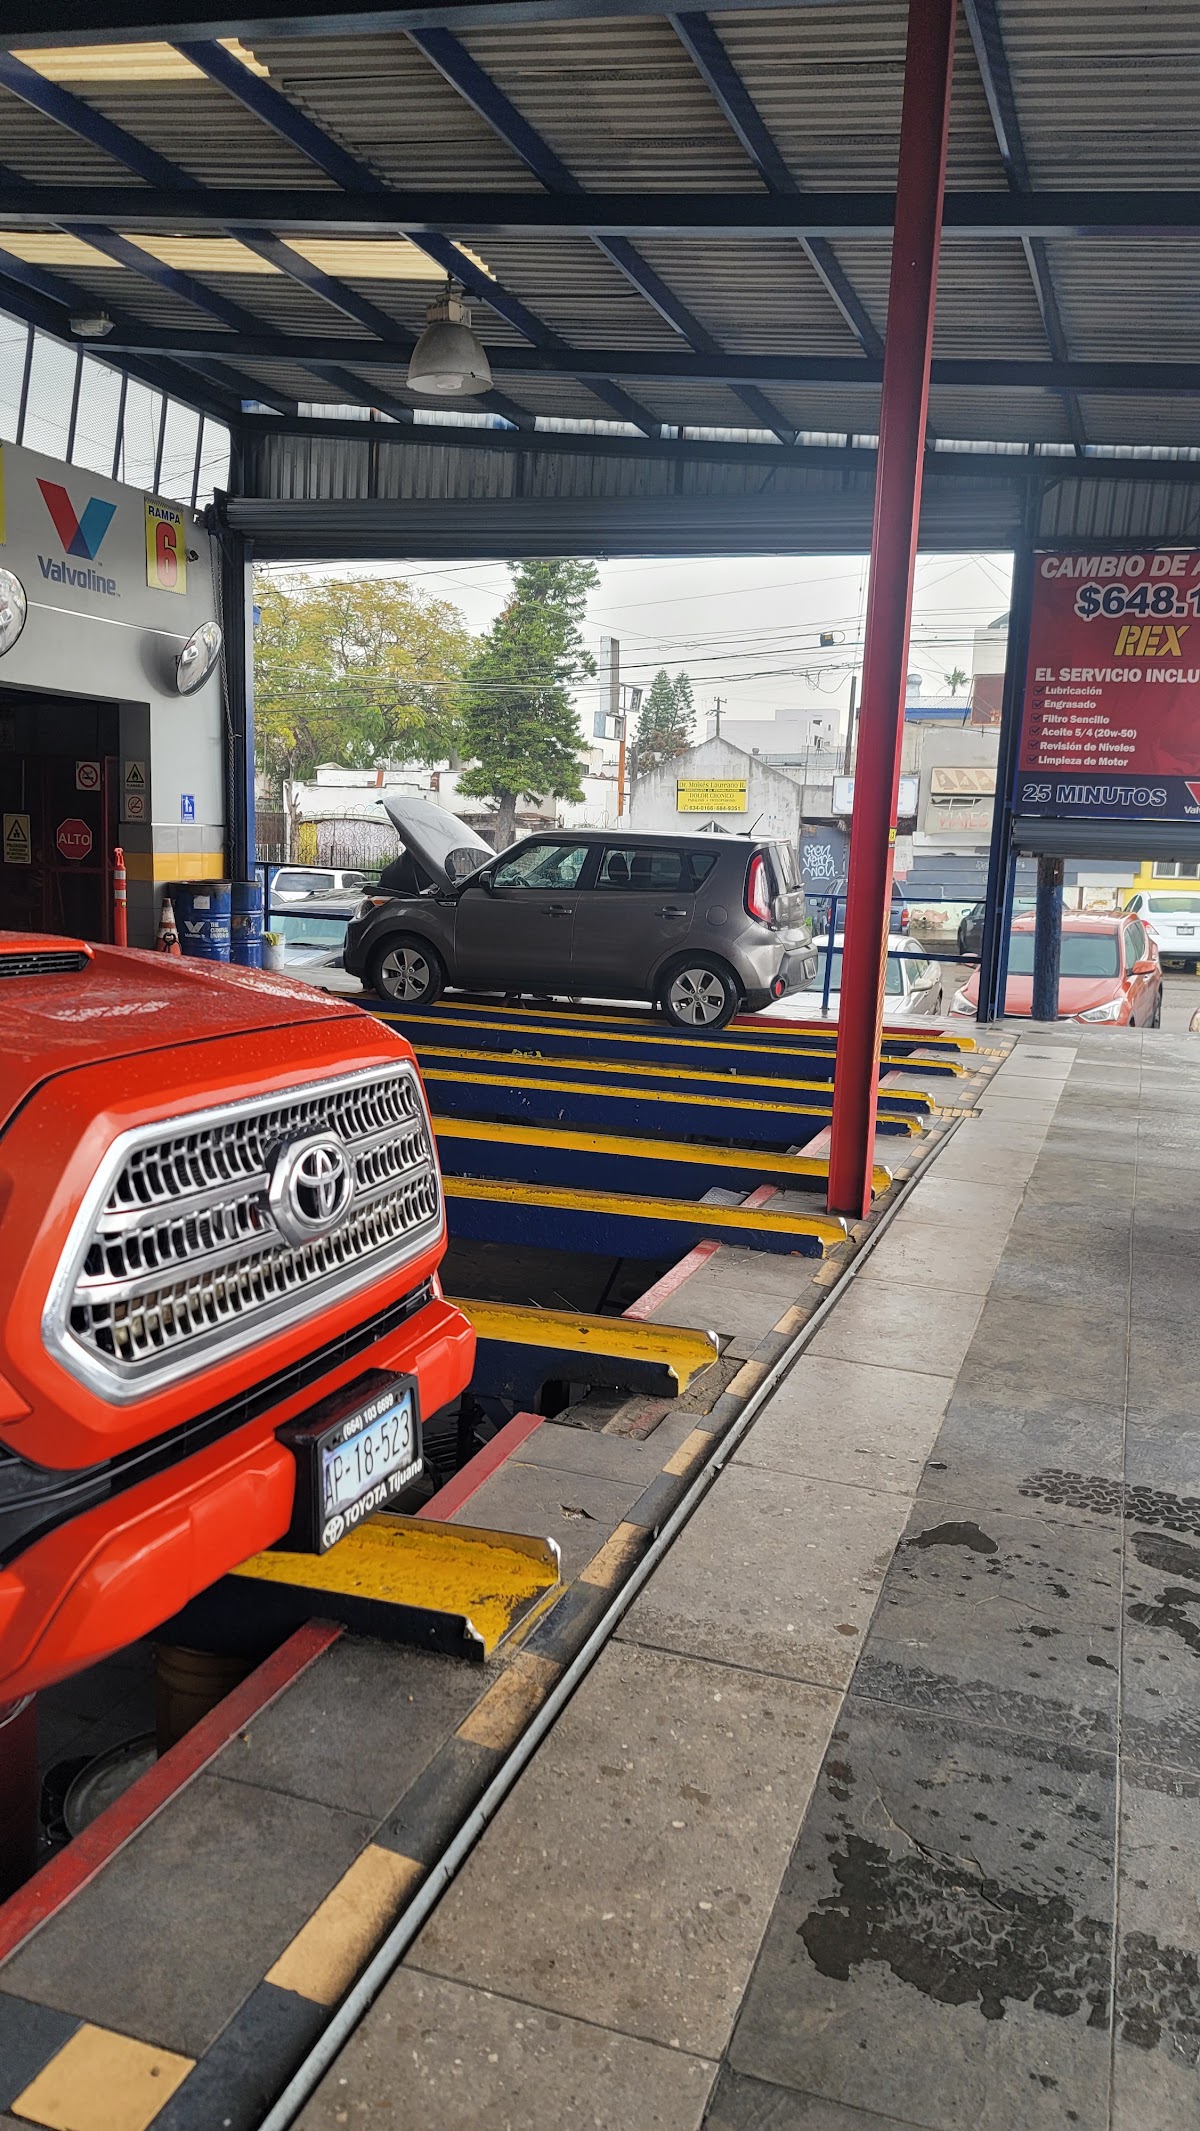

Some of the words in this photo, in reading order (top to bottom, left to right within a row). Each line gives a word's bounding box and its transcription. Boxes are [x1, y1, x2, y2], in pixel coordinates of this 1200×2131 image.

[148, 505, 181, 525] RAMPA
[155, 522, 177, 587] 6
[37, 555, 117, 595] Valvoline
[1040, 555, 1145, 579] CAMBIO
[1149, 555, 1190, 577] DE
[1114, 625, 1190, 657] REX
[1035, 668, 1055, 682] EL
[1059, 667, 1142, 683] SERVICIO
[1045, 686, 1102, 695] Lubricación
[1044, 700, 1096, 709] Engrasado
[1042, 714, 1068, 723] Filtro
[1070, 715, 1110, 724] Sencillo
[1041, 727, 1073, 736] Aceite
[1075, 728, 1093, 738] 5/4
[1094, 729, 1137, 739] (20w-50)
[1040, 741, 1082, 751] Revisión
[1083, 742, 1097, 751] de
[1098, 743, 1136, 753] Niveles
[1038, 756, 1082, 765] Limpieza
[1083, 757, 1097, 765] de
[1098, 757, 1129, 766] Motor
[1022, 784, 1052, 802] 25
[1056, 785, 1167, 806] MINUTOS
[58, 832, 90, 846] ALTO
[343, 1414, 363, 1440] (664)
[363, 1406, 378, 1424] 103
[325, 1409, 410, 1511] AP-18-523
[344, 1485, 388, 1527] TOYOTA
[388, 1458, 422, 1492] Tijuana
